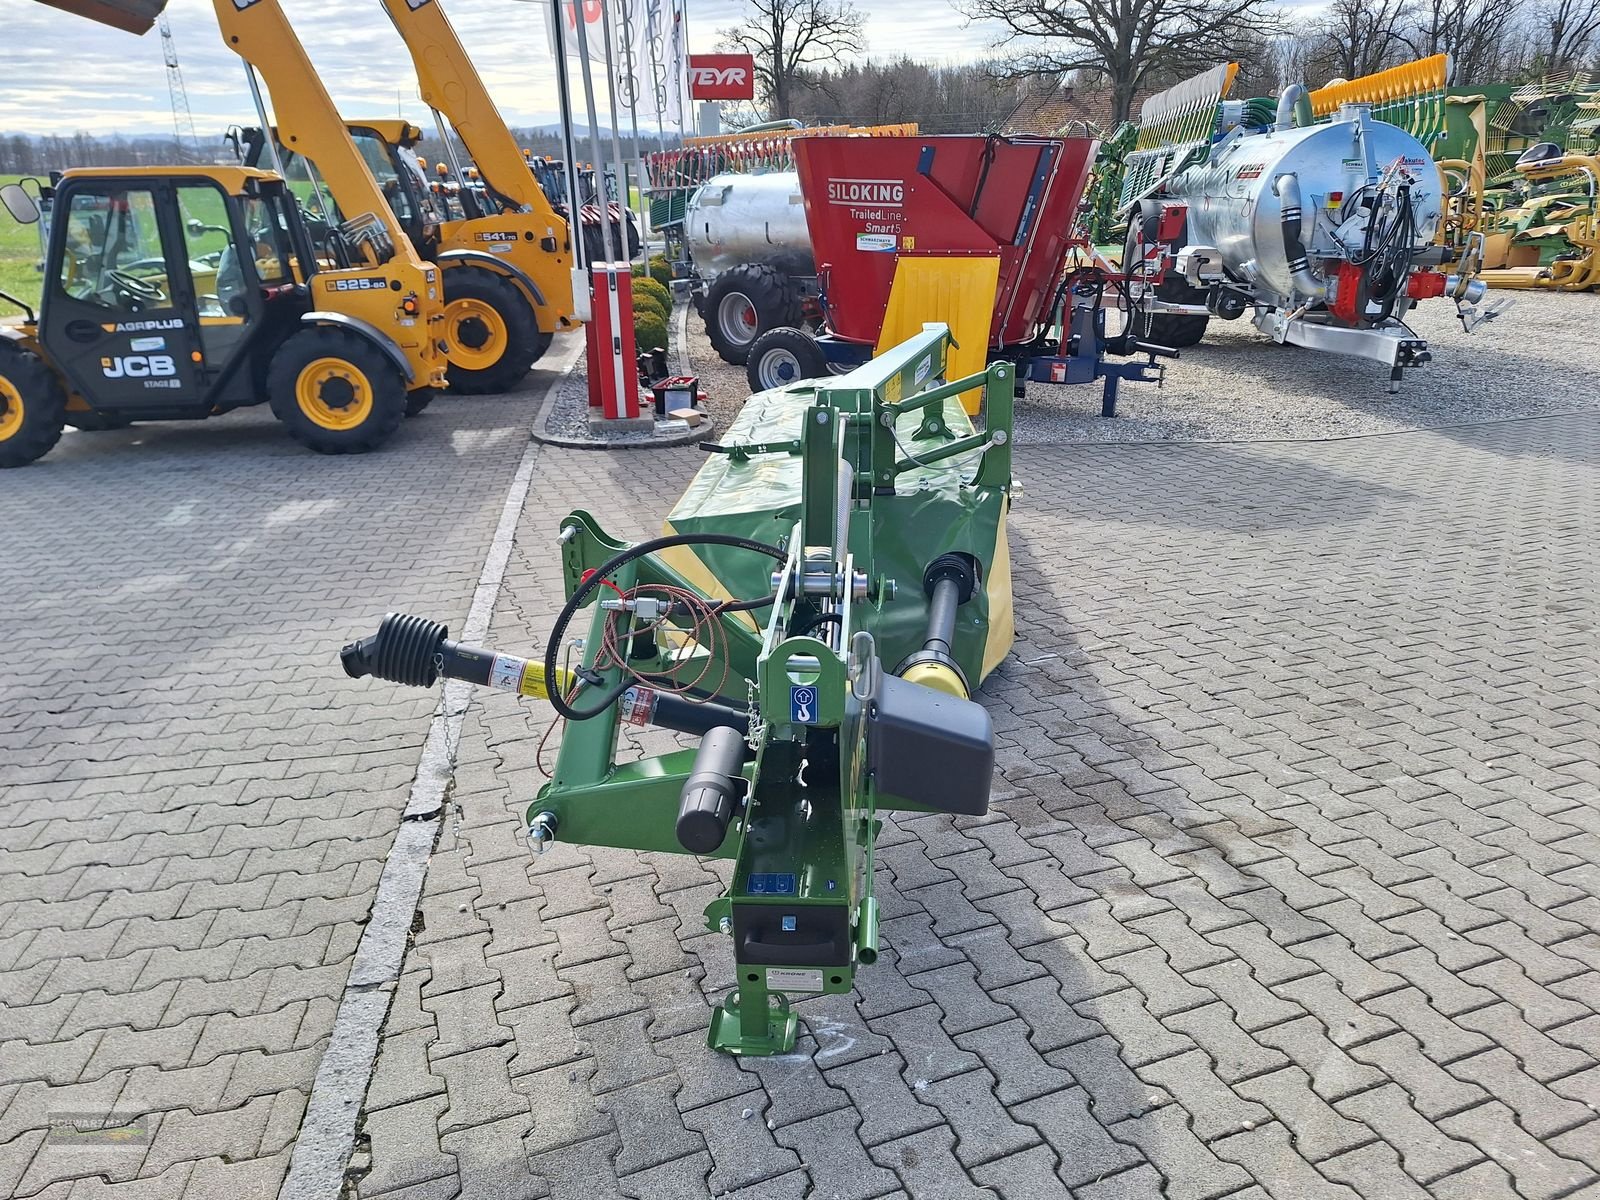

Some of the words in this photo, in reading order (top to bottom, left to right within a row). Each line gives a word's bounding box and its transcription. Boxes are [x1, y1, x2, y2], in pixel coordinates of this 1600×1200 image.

[688, 67, 746, 86] TEYR
[828, 183, 903, 201] SILOKING
[850, 208, 901, 221] TrailedLine
[102, 355, 176, 378] JCB
